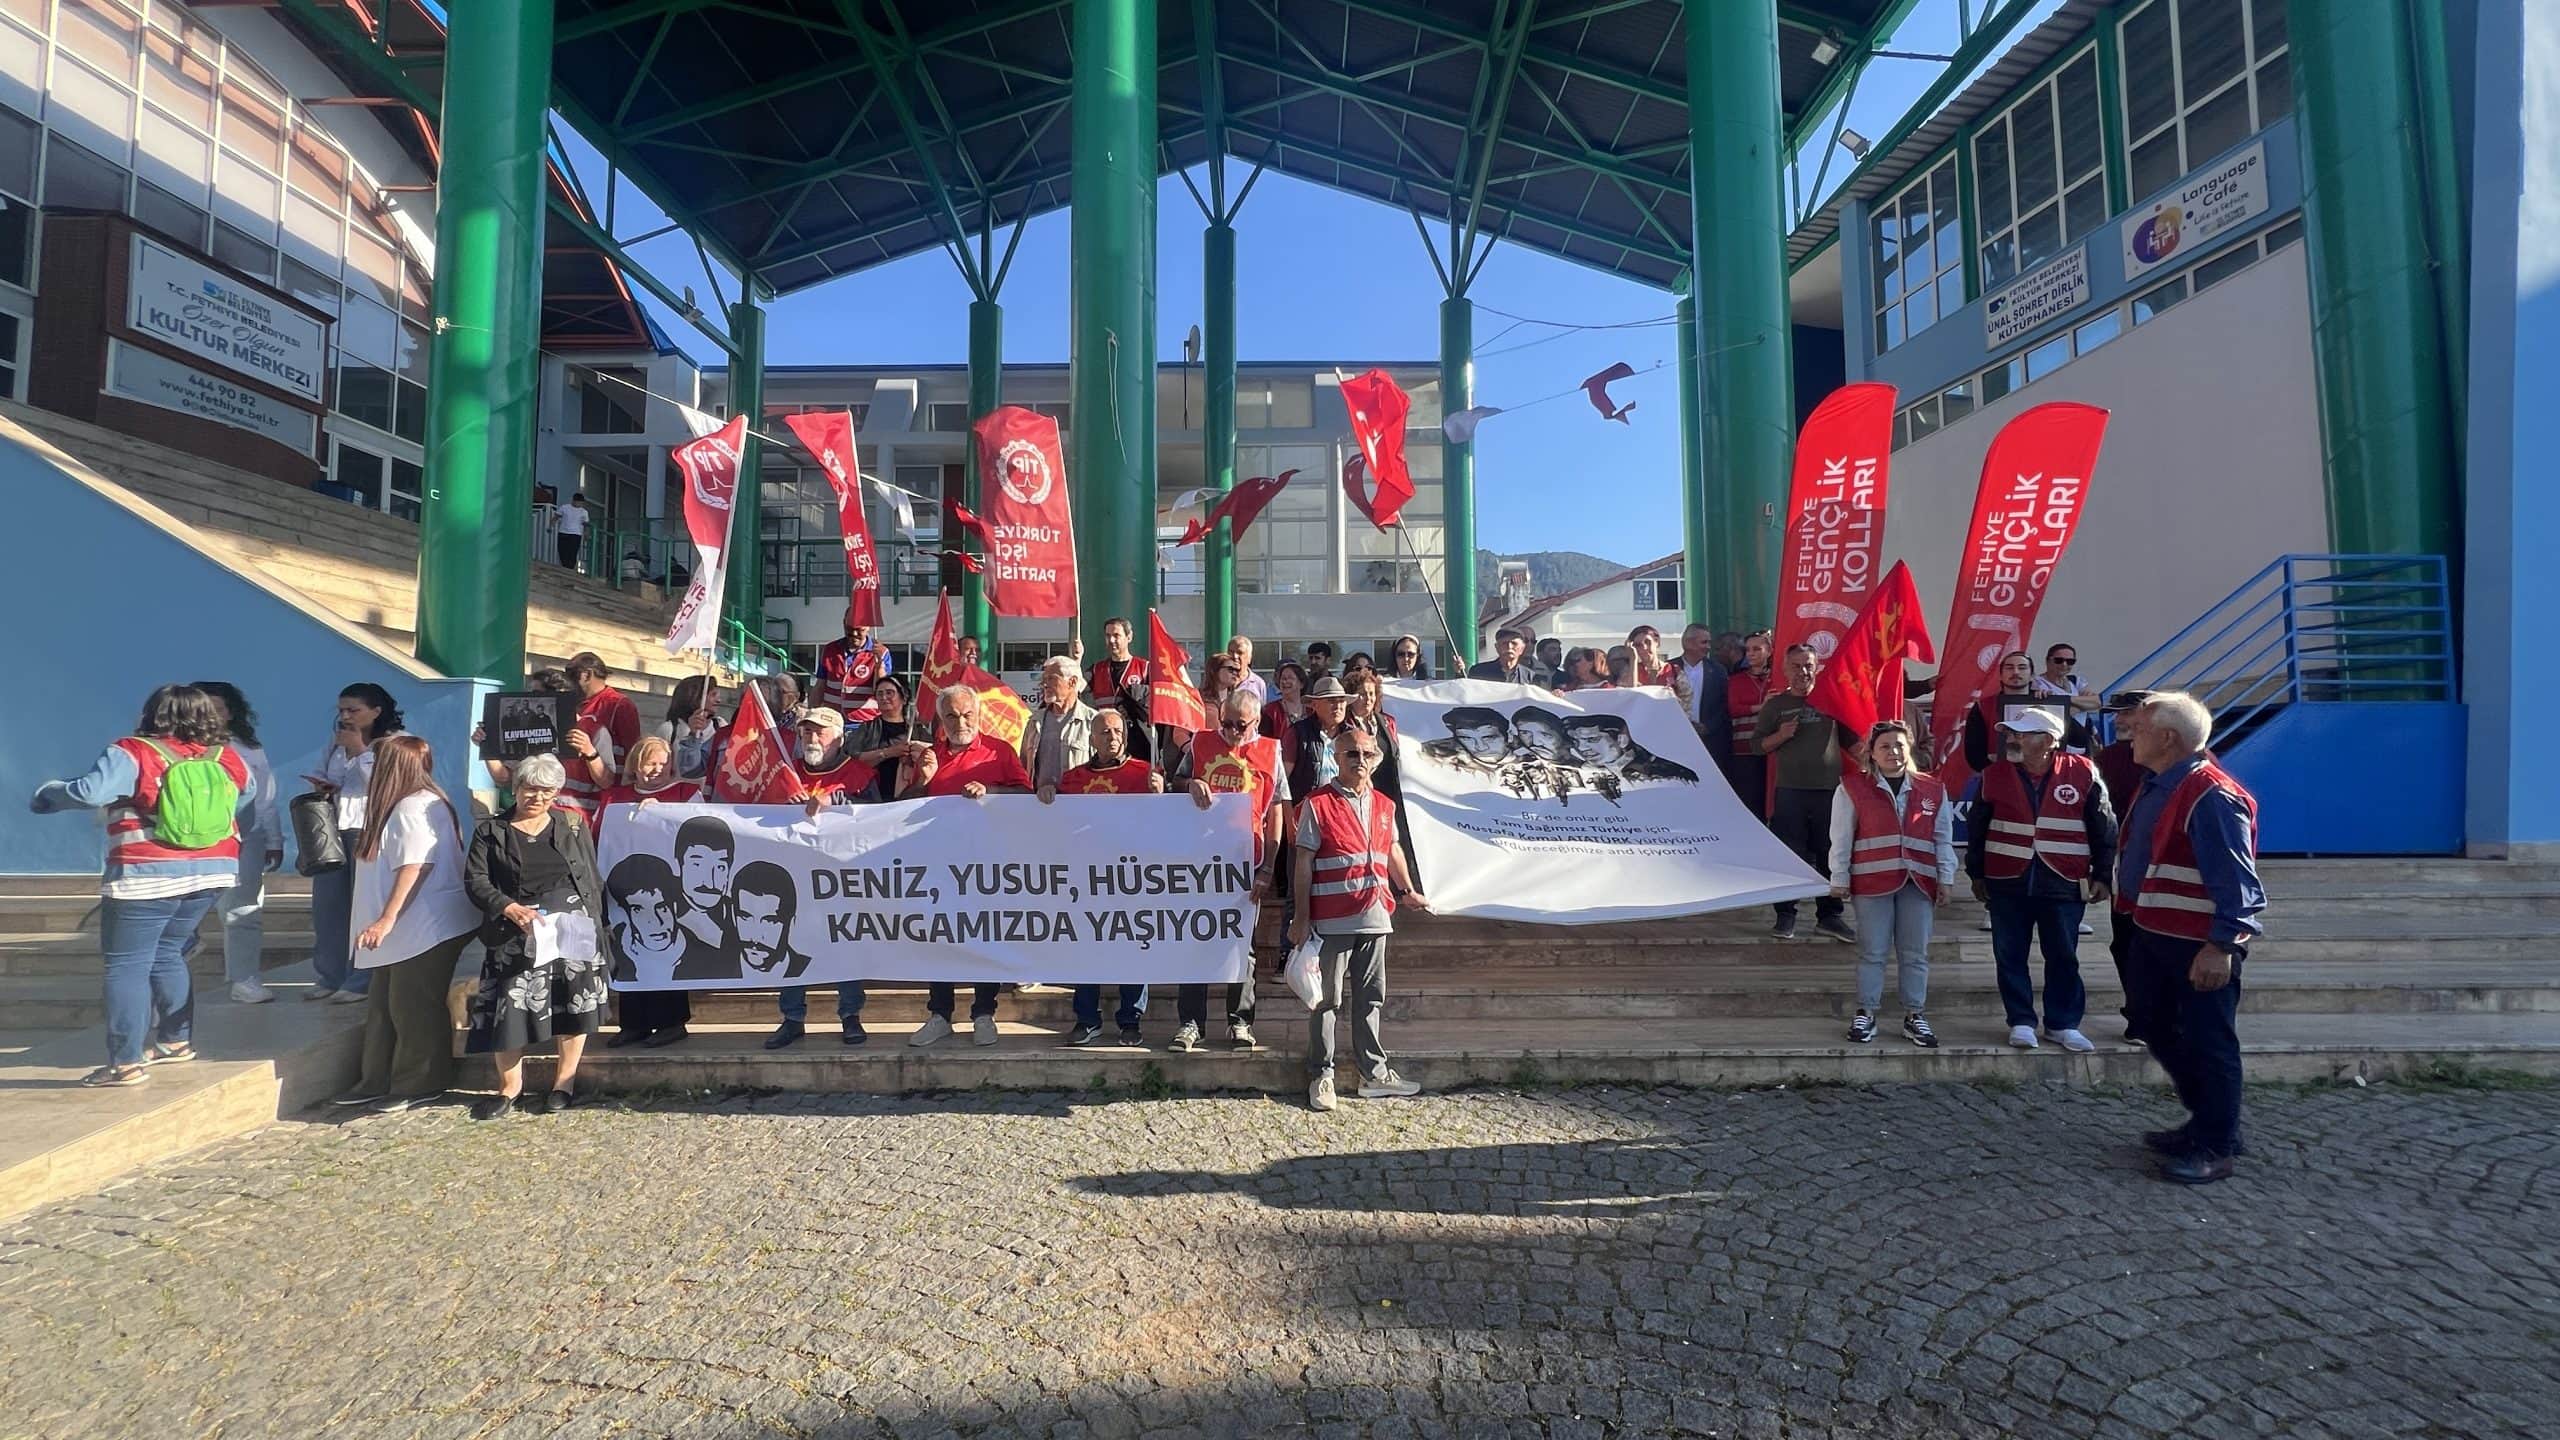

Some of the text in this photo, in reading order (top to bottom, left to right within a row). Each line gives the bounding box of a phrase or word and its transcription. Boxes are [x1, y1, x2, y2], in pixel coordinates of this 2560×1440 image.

[2182, 156, 2257, 203] Language
[1796, 497, 1818, 592] FETHİYE
[1812, 455, 1848, 594] GENÇLİK
[1842, 457, 1877, 593] KOLLARI
[1989, 472, 2042, 607] GENÇLİK
[1971, 511, 2004, 602] FETHİYE
[1210, 773, 1244, 790] EMEP
[1456, 821, 1515, 838] Mustafa
[1518, 831, 1563, 842] Kemal
[1544, 813, 1560, 822] de
[1565, 814, 1600, 823] onlar
[1604, 815, 1629, 824] gibi
[1645, 824, 1671, 835] için
[1607, 847, 1635, 856] and
[811, 855, 1251, 904] DENİZ, YUSUF, HÜSEYİN
[828, 908, 1245, 950] KAVGAMIZDA YAŞIYOR
